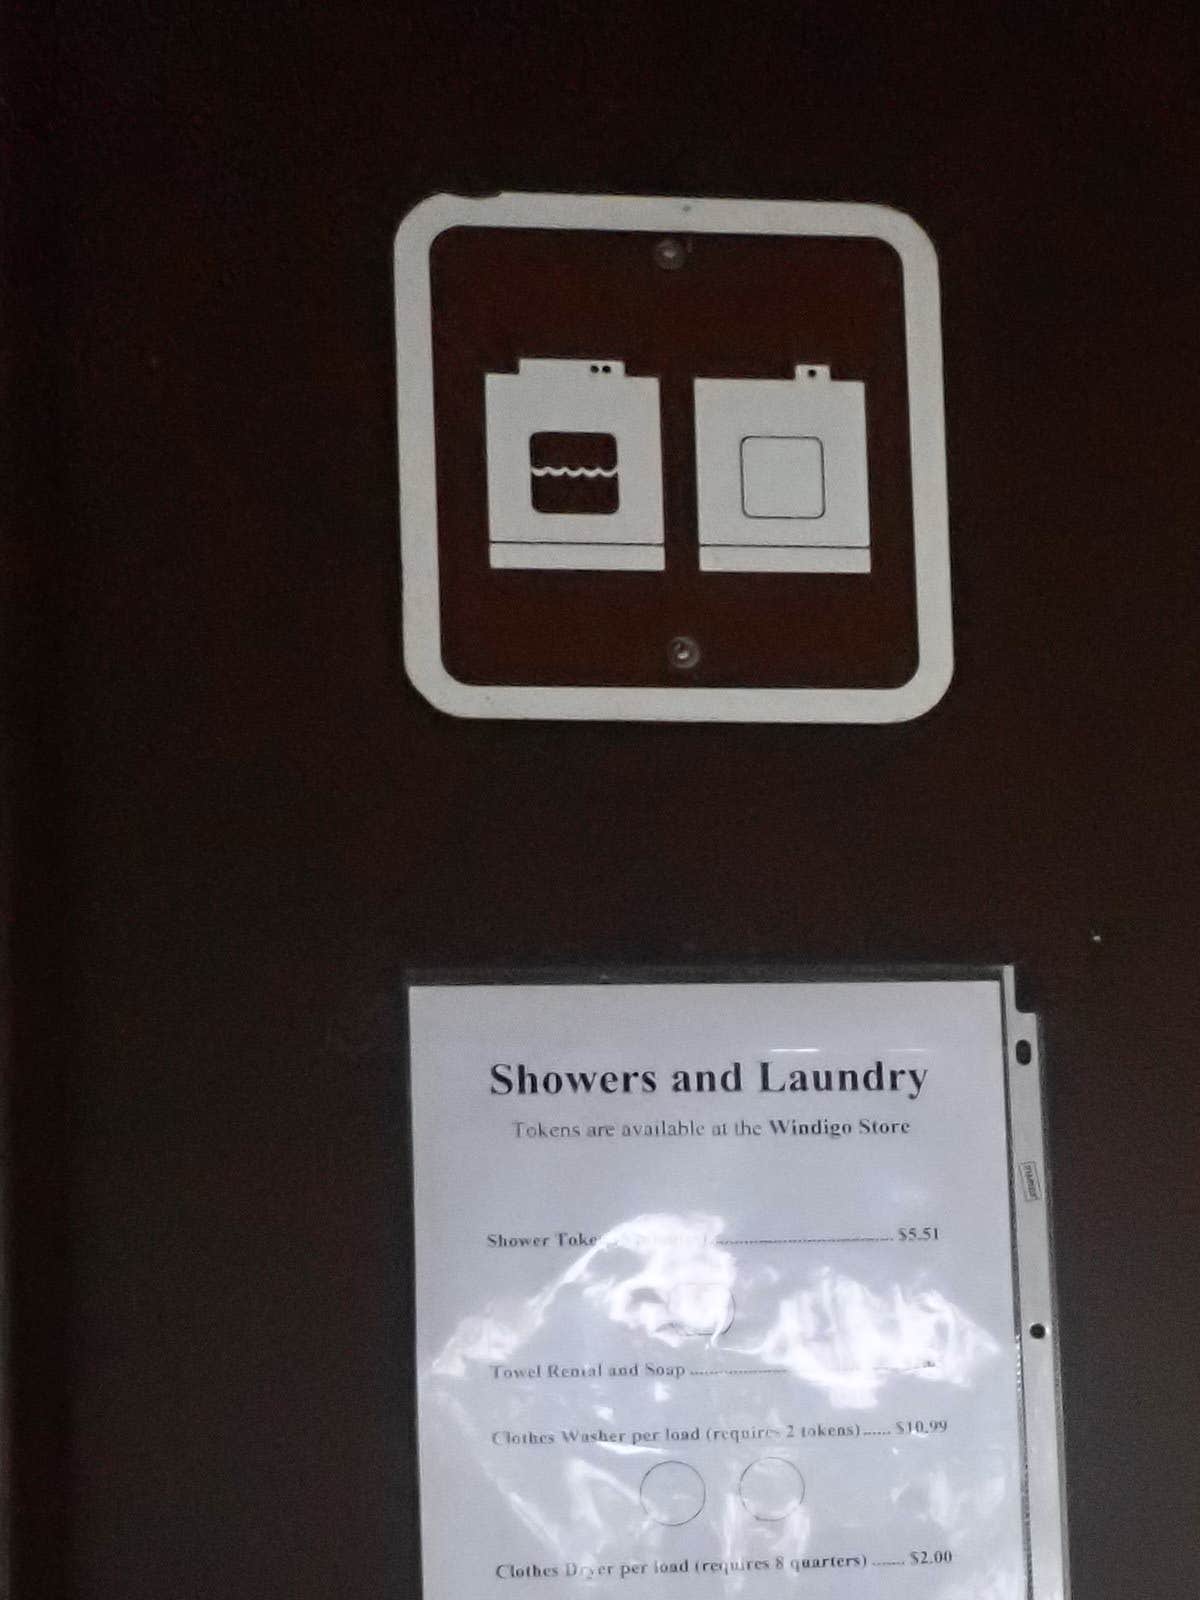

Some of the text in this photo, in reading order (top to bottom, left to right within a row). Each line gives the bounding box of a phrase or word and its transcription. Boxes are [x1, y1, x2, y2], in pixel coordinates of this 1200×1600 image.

[491, 1061, 928, 1100] Showers and Laundry
[512, 1119, 911, 1139] Tokens are available at the Windigo Store
[487, 1233, 549, 1249] Shower
[554, 1232, 599, 1248] Toke
[897, 1227, 940, 1242] $5.51
[489, 1363, 686, 1379] Towel Rental and Soap
[491, 1430, 555, 1445] Clothes
[561, 1430, 626, 1443] Washer
[632, 1430, 659, 1444] per
[665, 1428, 700, 1441] load
[787, 1425, 795, 1438] 2
[802, 1424, 860, 1438] tokens)
[896, 1420, 948, 1434] $10.99
[495, 1563, 559, 1579] Clothes
[620, 1563, 648, 1579] per
[654, 1560, 689, 1573] load
[694, 1558, 770, 1575] (requires
[776, 1556, 784, 1569] 8
[790, 1555, 867, 1572] quarters)
[910, 1551, 953, 1565] $2.00
